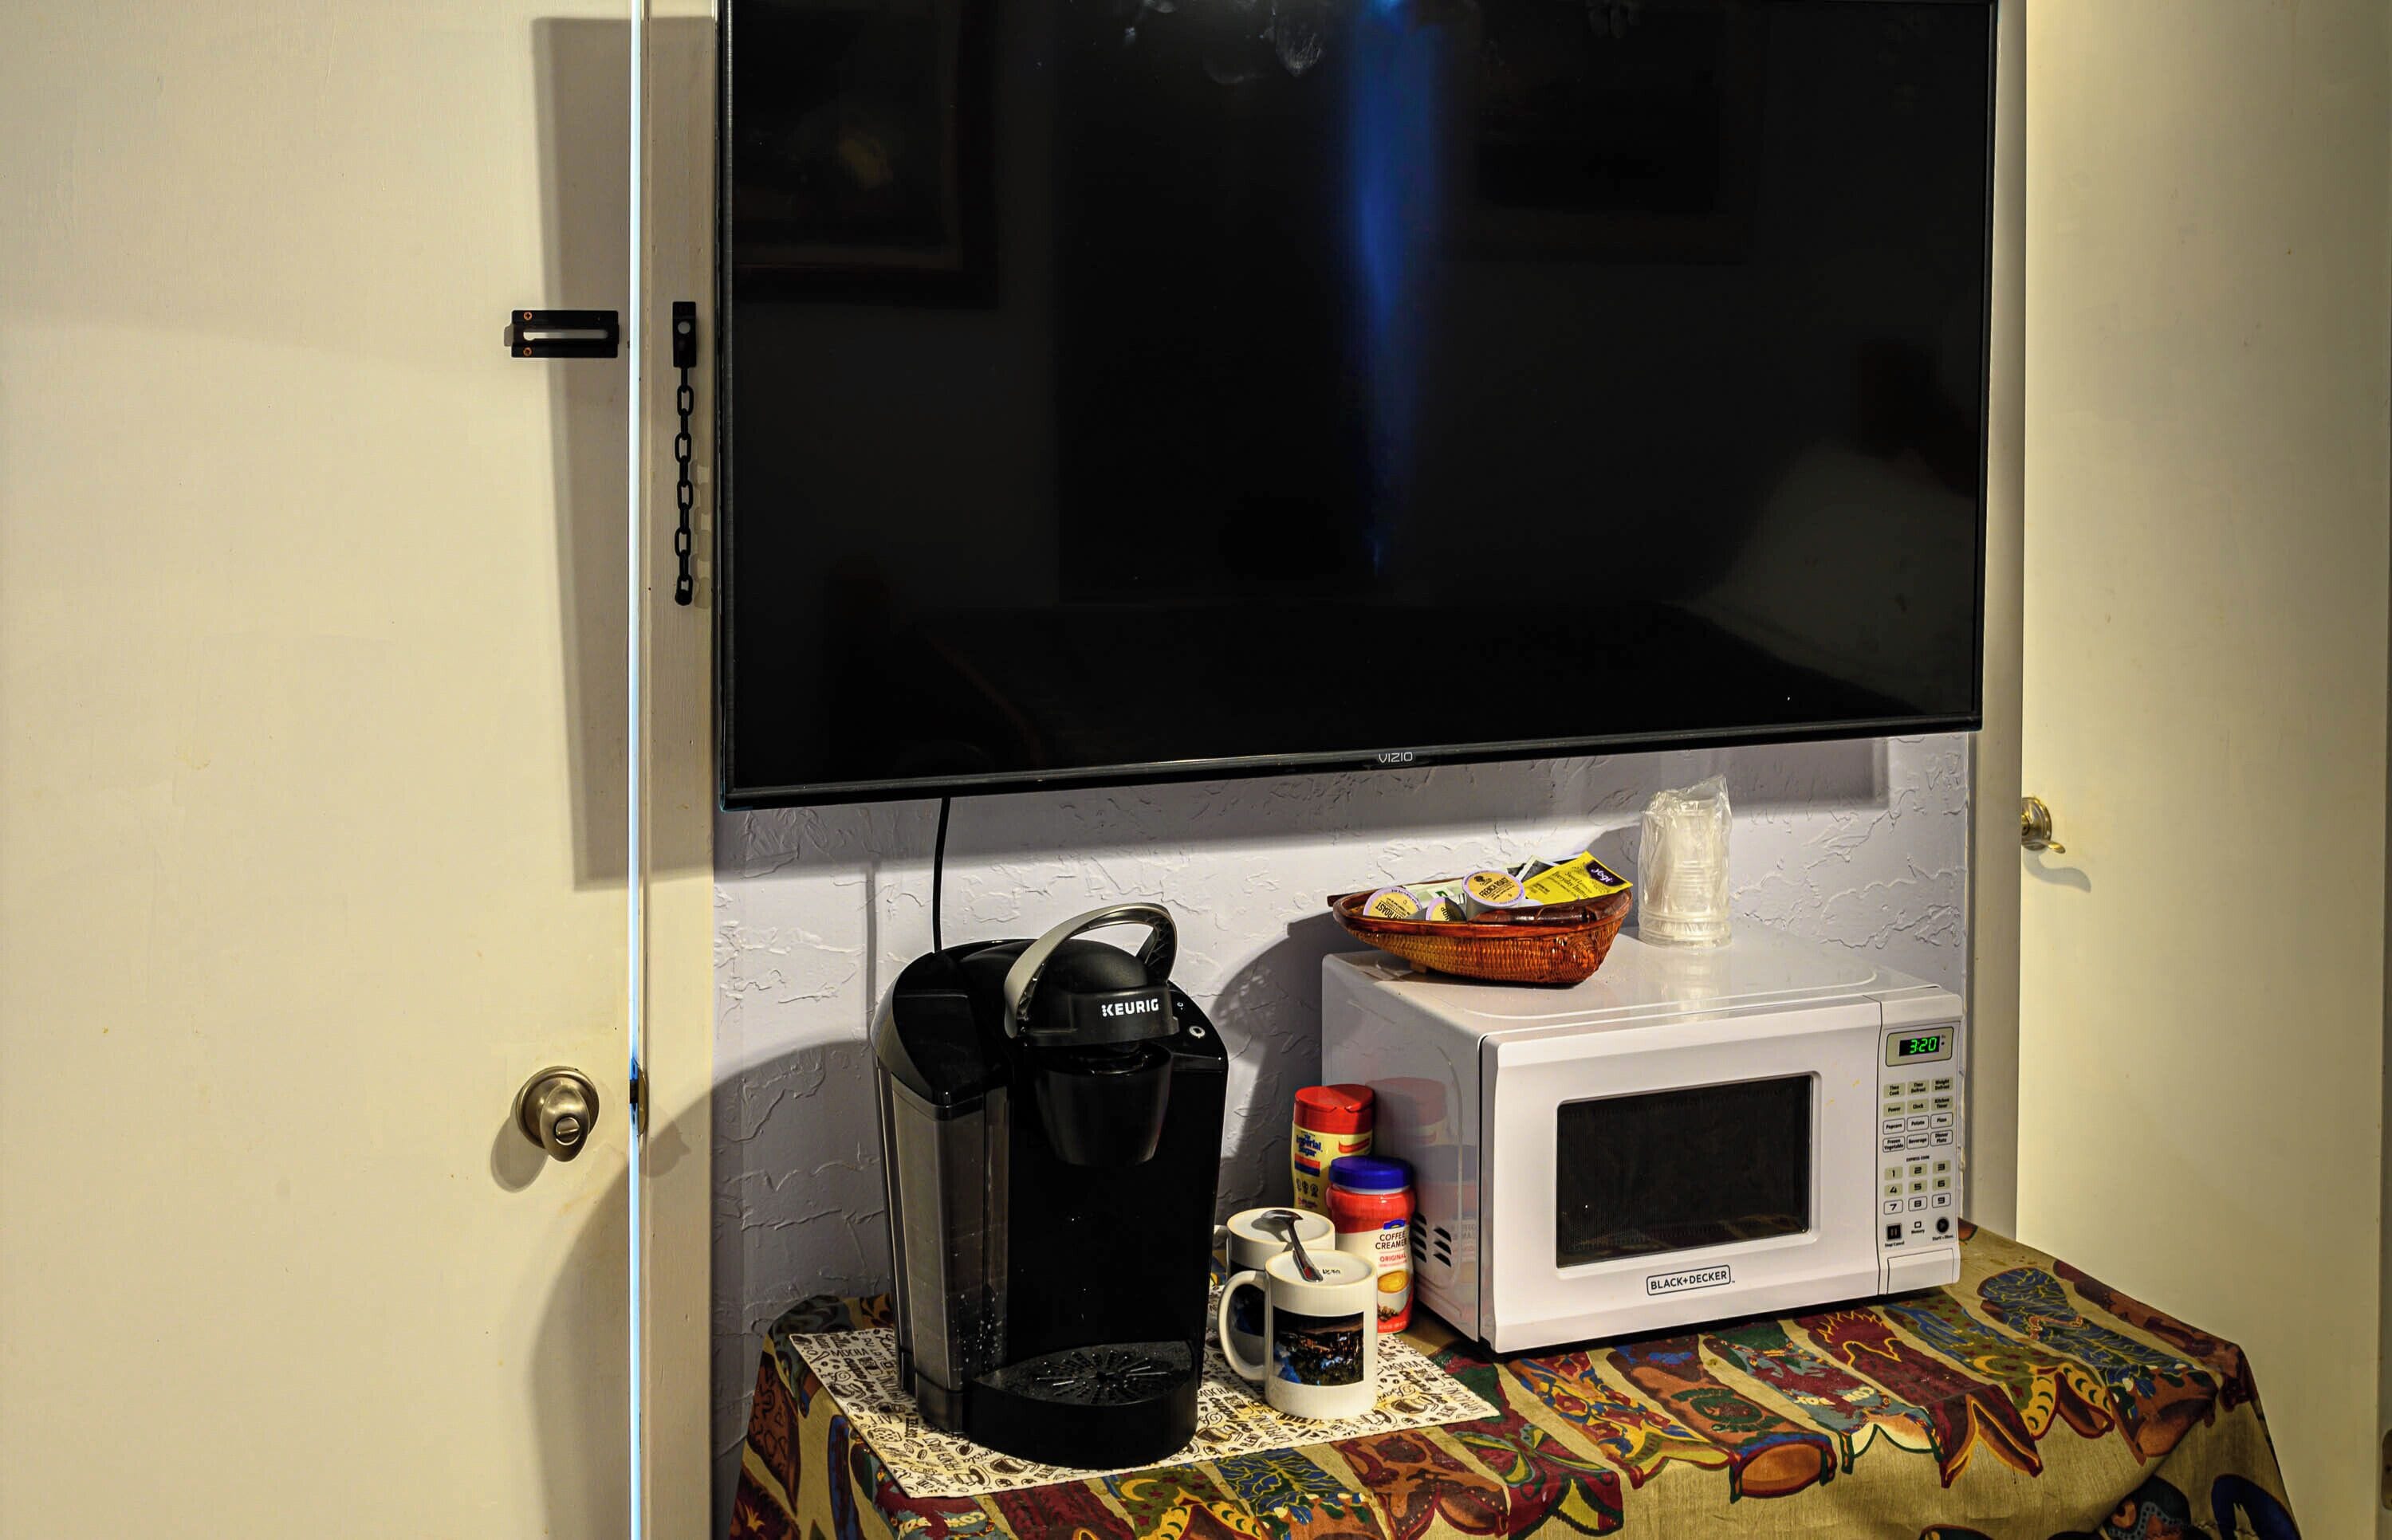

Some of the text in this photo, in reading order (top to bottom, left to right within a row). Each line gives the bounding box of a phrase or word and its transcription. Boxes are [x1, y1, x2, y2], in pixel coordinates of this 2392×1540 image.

[1379, 752, 1413, 763] VIZIO
[1591, 867, 1612, 883] yogi
[1479, 884, 1498, 898] FRENCH
[1493, 877, 1509, 887] ROAST
[1375, 902, 1395, 919] ROAST
[1101, 998, 1159, 1017] KEURIG
[1910, 1037, 1938, 1054] 3:20
[1379, 1231, 1406, 1241] COFFEE
[1375, 1238, 1407, 1250] CREAMER
[1380, 1253, 1406, 1262] ORIGINAL
[1650, 1271, 1727, 1291] BLACK+DECKER
[830, 1348, 870, 1357] MOCHA
[1383, 1360, 1422, 1373] MOCHA
[1198, 1386, 1232, 1398] MOCHA
